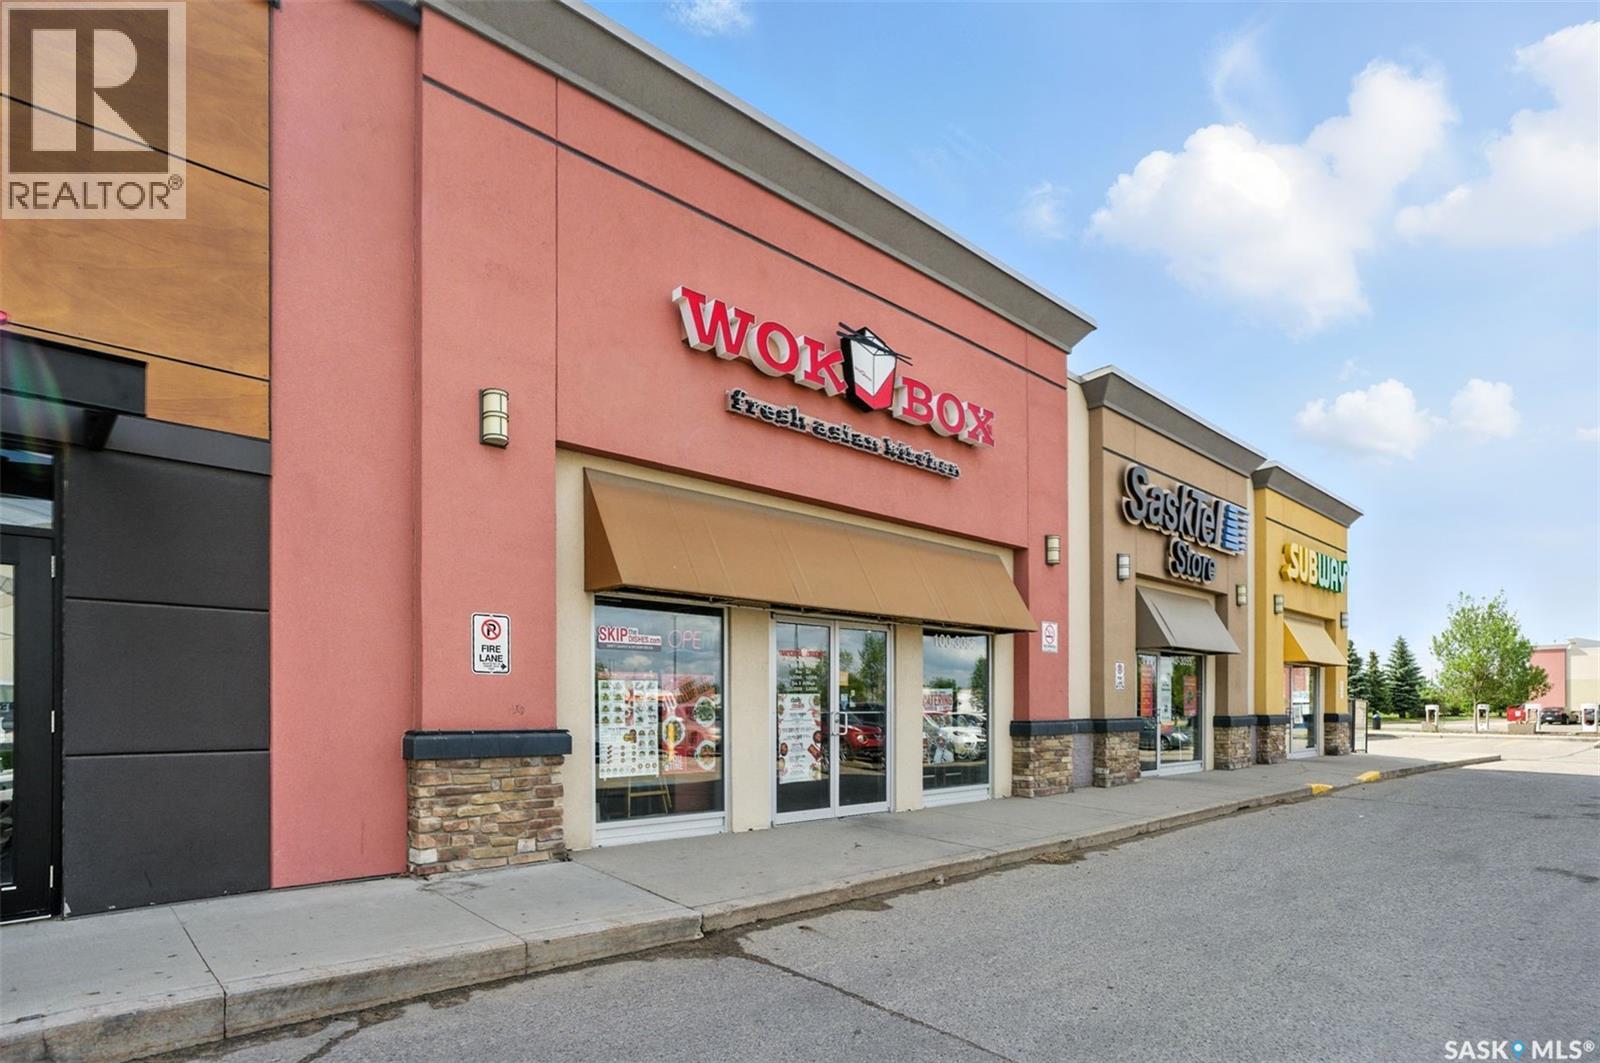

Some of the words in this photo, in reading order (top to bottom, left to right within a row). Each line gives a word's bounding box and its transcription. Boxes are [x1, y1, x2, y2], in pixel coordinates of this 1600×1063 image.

[674, 286, 848, 397] WOK
[892, 376, 994, 448] BOX
[728, 389, 807, 432] fresh
[811, 418, 880, 453] asian
[1121, 464, 1223, 548] SaskTel
[1169, 538, 1217, 584] Store
[1281, 543, 1347, 593] SUBWAY
[481, 644, 501, 653] FIRE
[599, 626, 628, 642] SKIP
[479, 654, 503, 663] LANE
